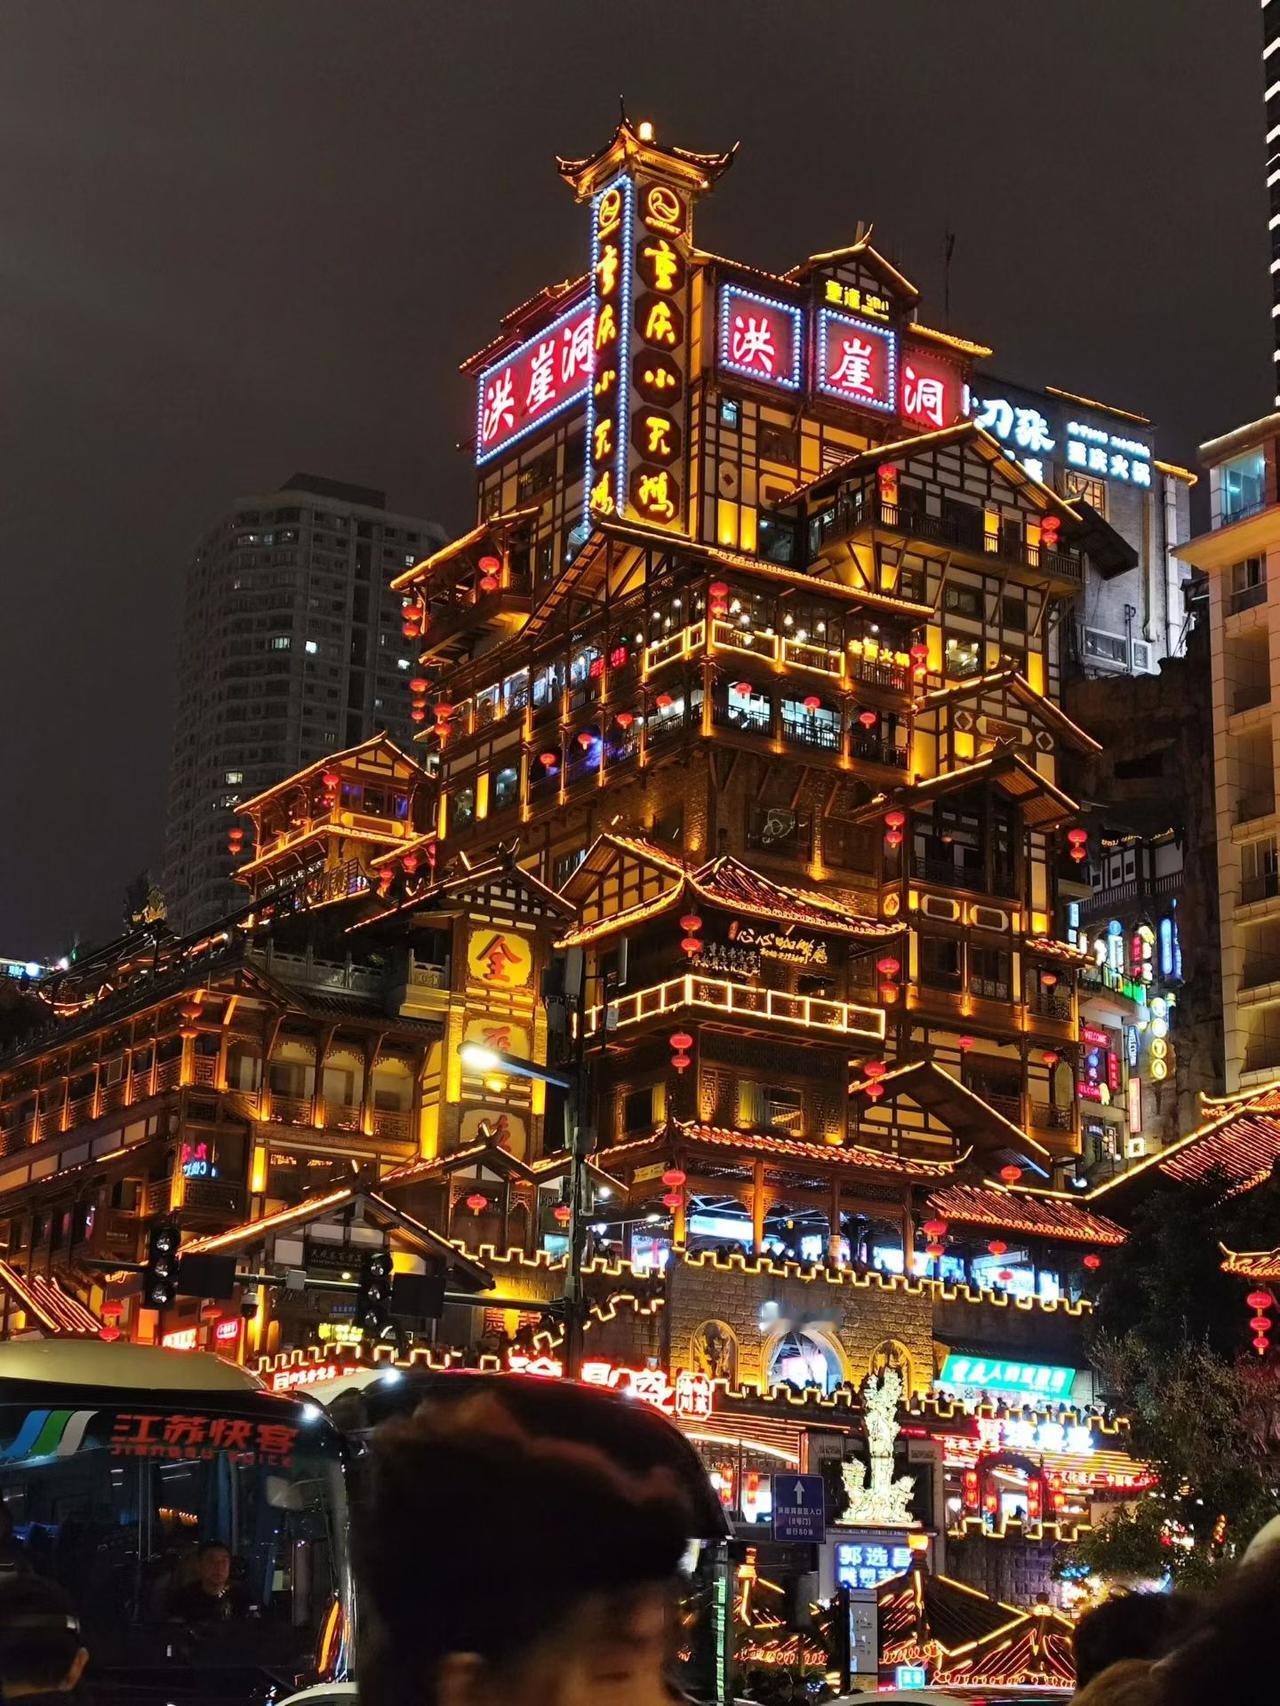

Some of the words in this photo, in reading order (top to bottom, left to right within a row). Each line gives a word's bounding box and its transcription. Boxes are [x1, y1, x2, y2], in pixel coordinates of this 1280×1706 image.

[482, 315, 596, 443] 洪崖洞
[732, 314, 945, 428] 洪崖洞
[109, 1413, 300, 1454] 江苏快客
[839, 1545, 913, 1568] 郭选昌
